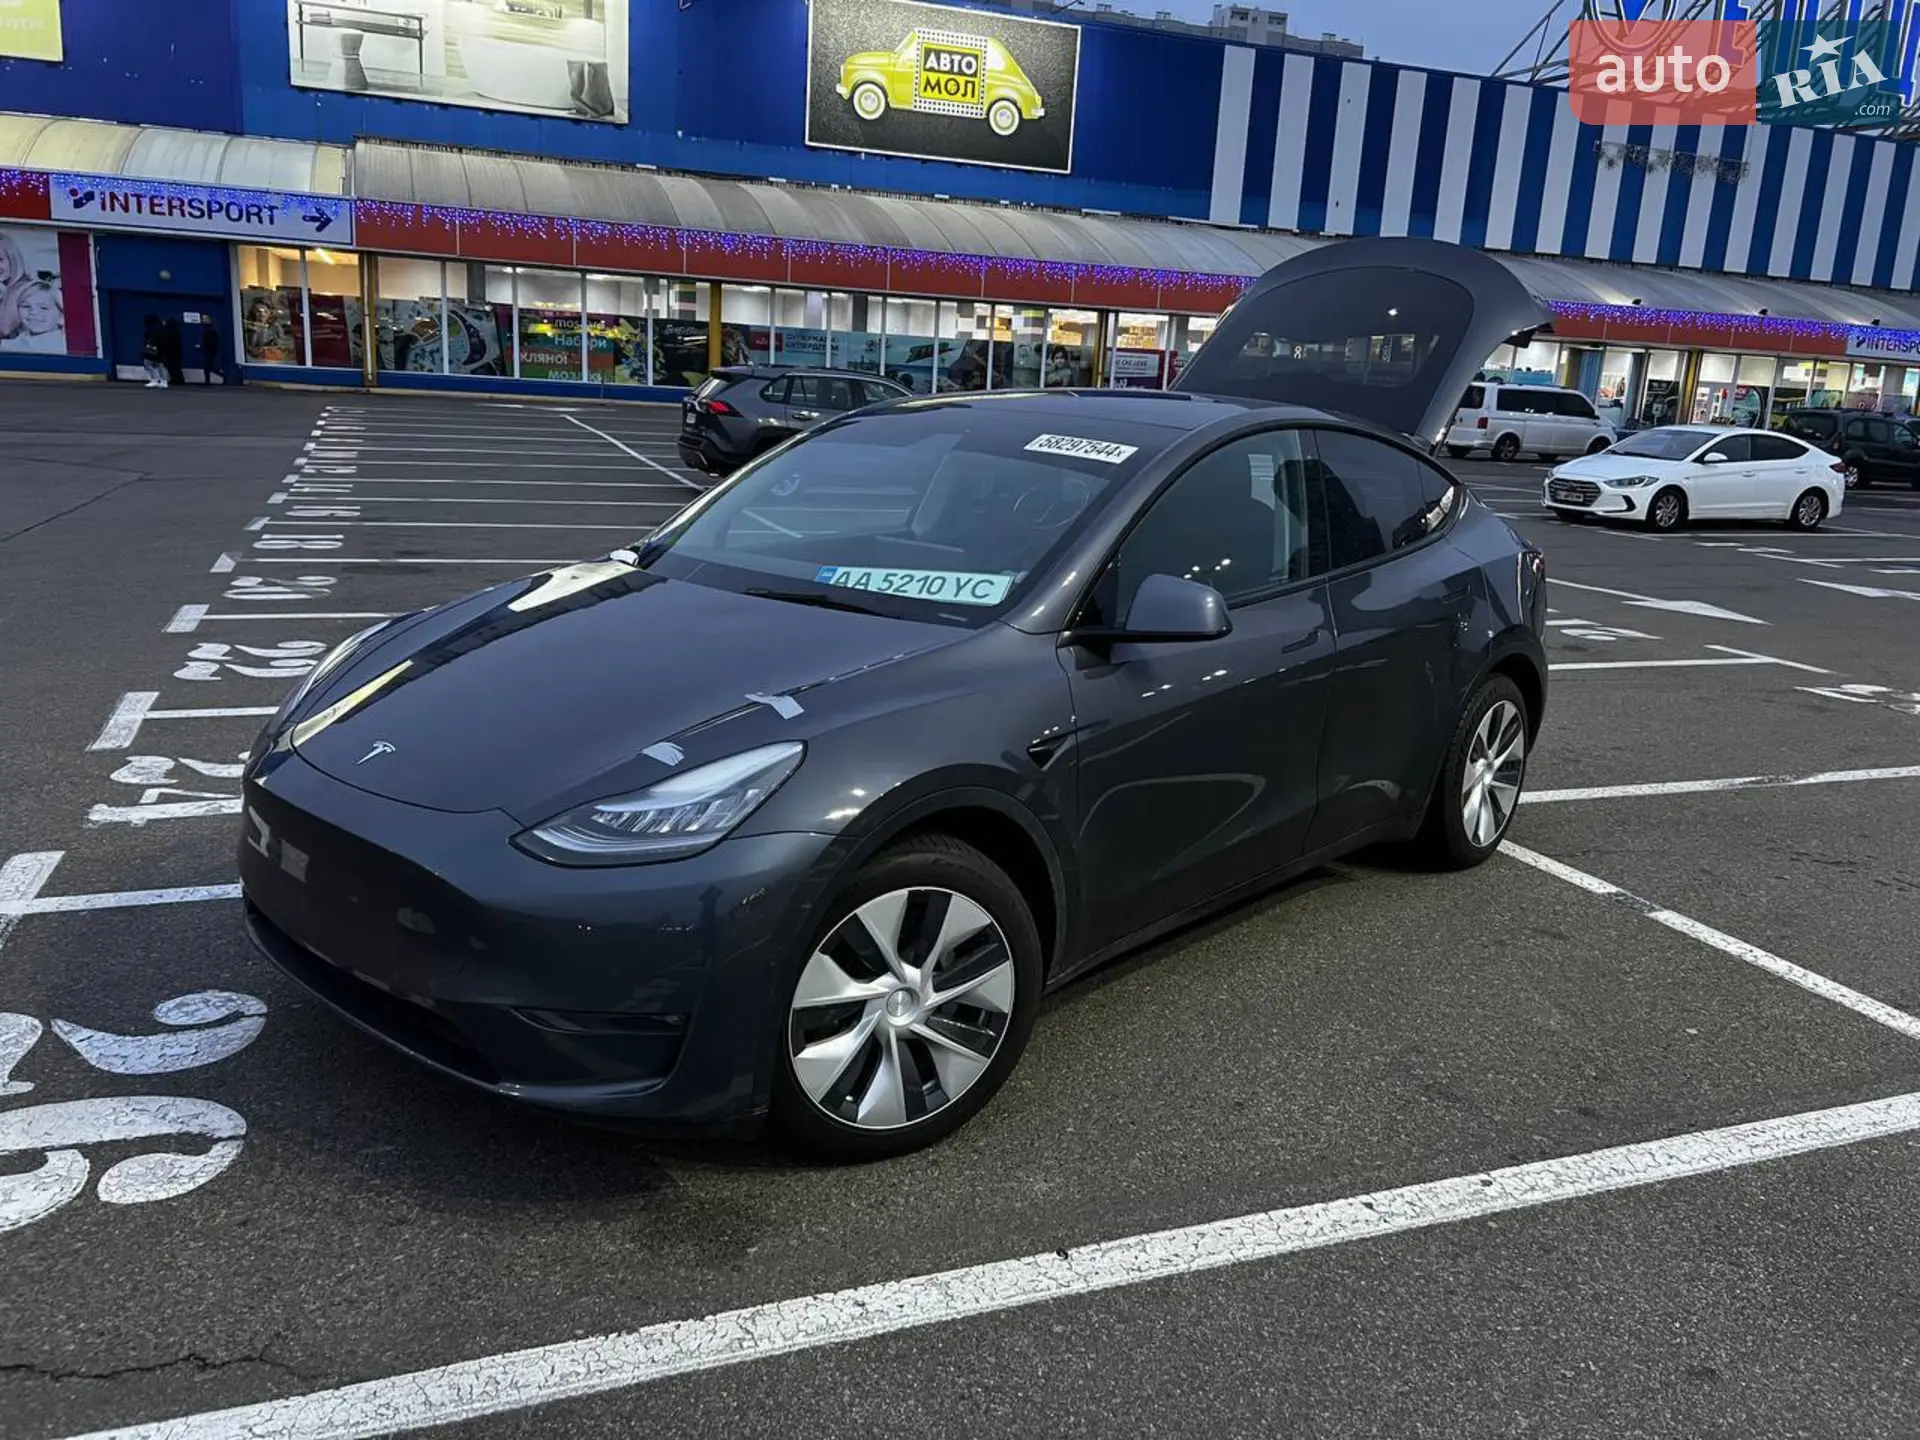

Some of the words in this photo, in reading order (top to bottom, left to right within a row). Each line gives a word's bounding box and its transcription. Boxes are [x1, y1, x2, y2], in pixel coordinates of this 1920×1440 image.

[925, 52, 977, 75] АВТО
[924, 77, 976, 98] МОЛ
[99, 191, 279, 226] INTERSPORT
[554, 335, 607, 350] Набри
[834, 570, 872, 590] AA
[877, 572, 947, 595] 5210
[953, 577, 995, 600] YC
